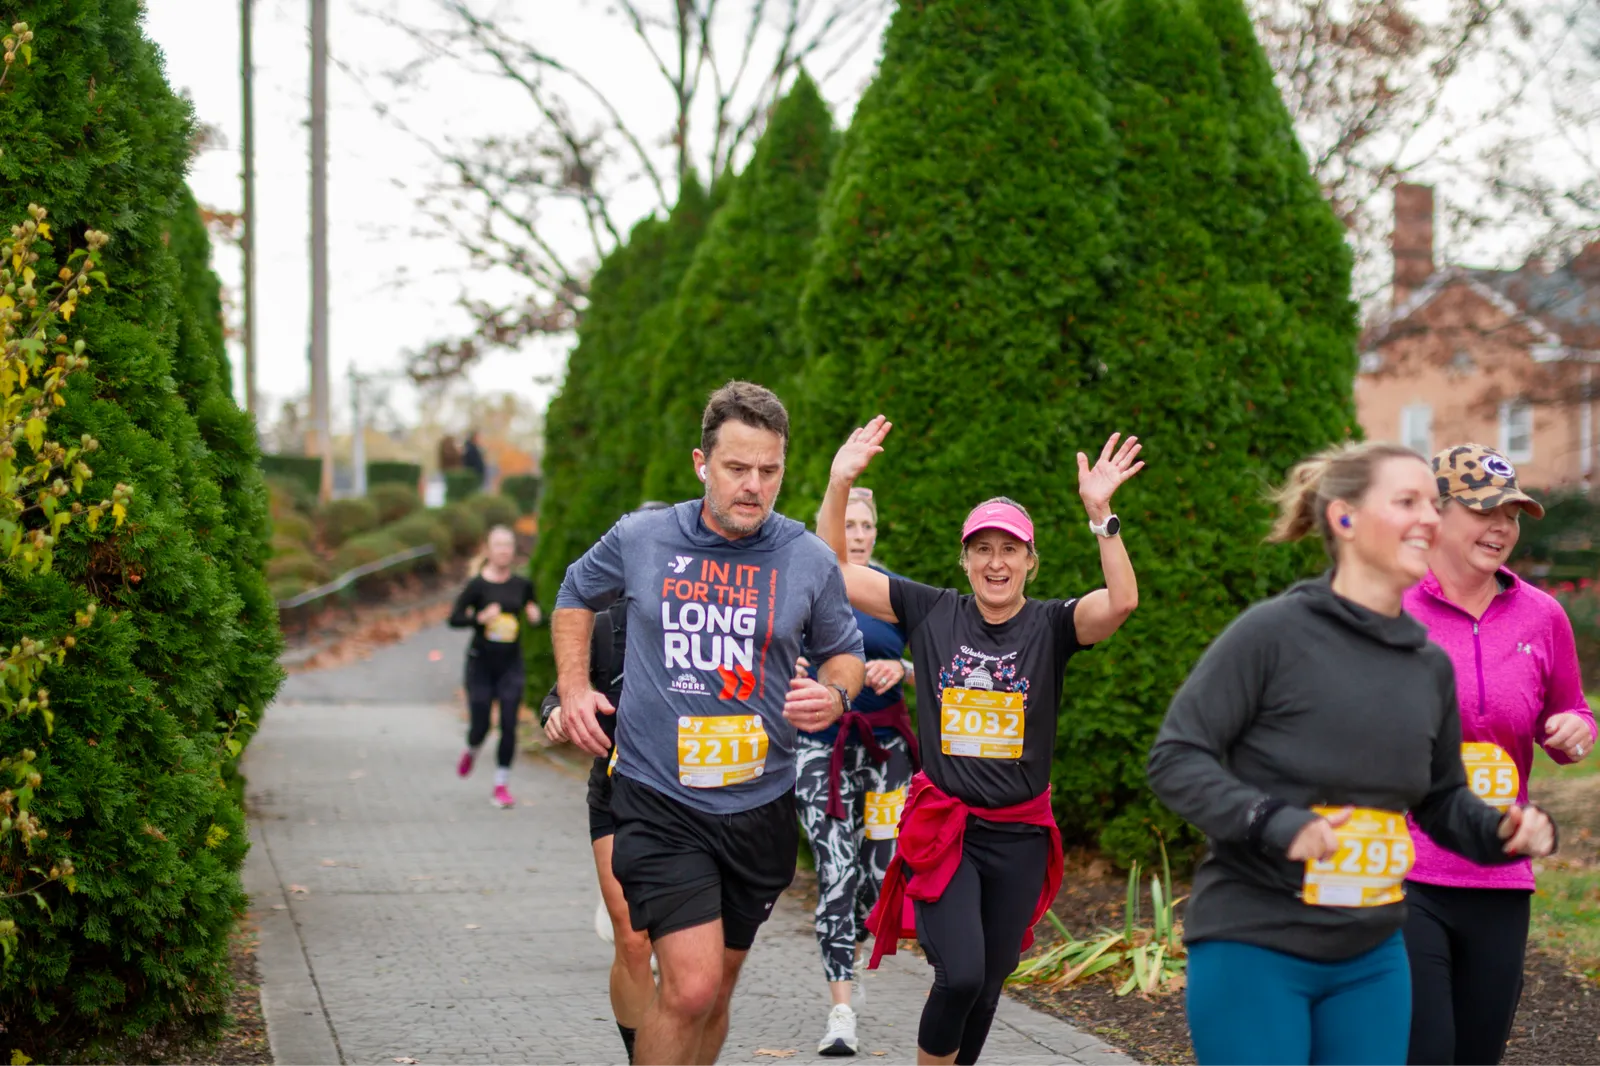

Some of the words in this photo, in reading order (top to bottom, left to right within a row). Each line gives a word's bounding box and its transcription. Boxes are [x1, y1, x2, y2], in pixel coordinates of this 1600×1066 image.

[701, 559, 730, 585] IN
[735, 564, 761, 588] IT
[662, 577, 709, 602] FOR
[713, 584, 759, 608] THE
[661, 601, 757, 636] LONG
[664, 632, 754, 672] RUN
[960, 645, 1000, 661] Washington
[944, 708, 1019, 737] 2032
[683, 737, 760, 764] 2211
